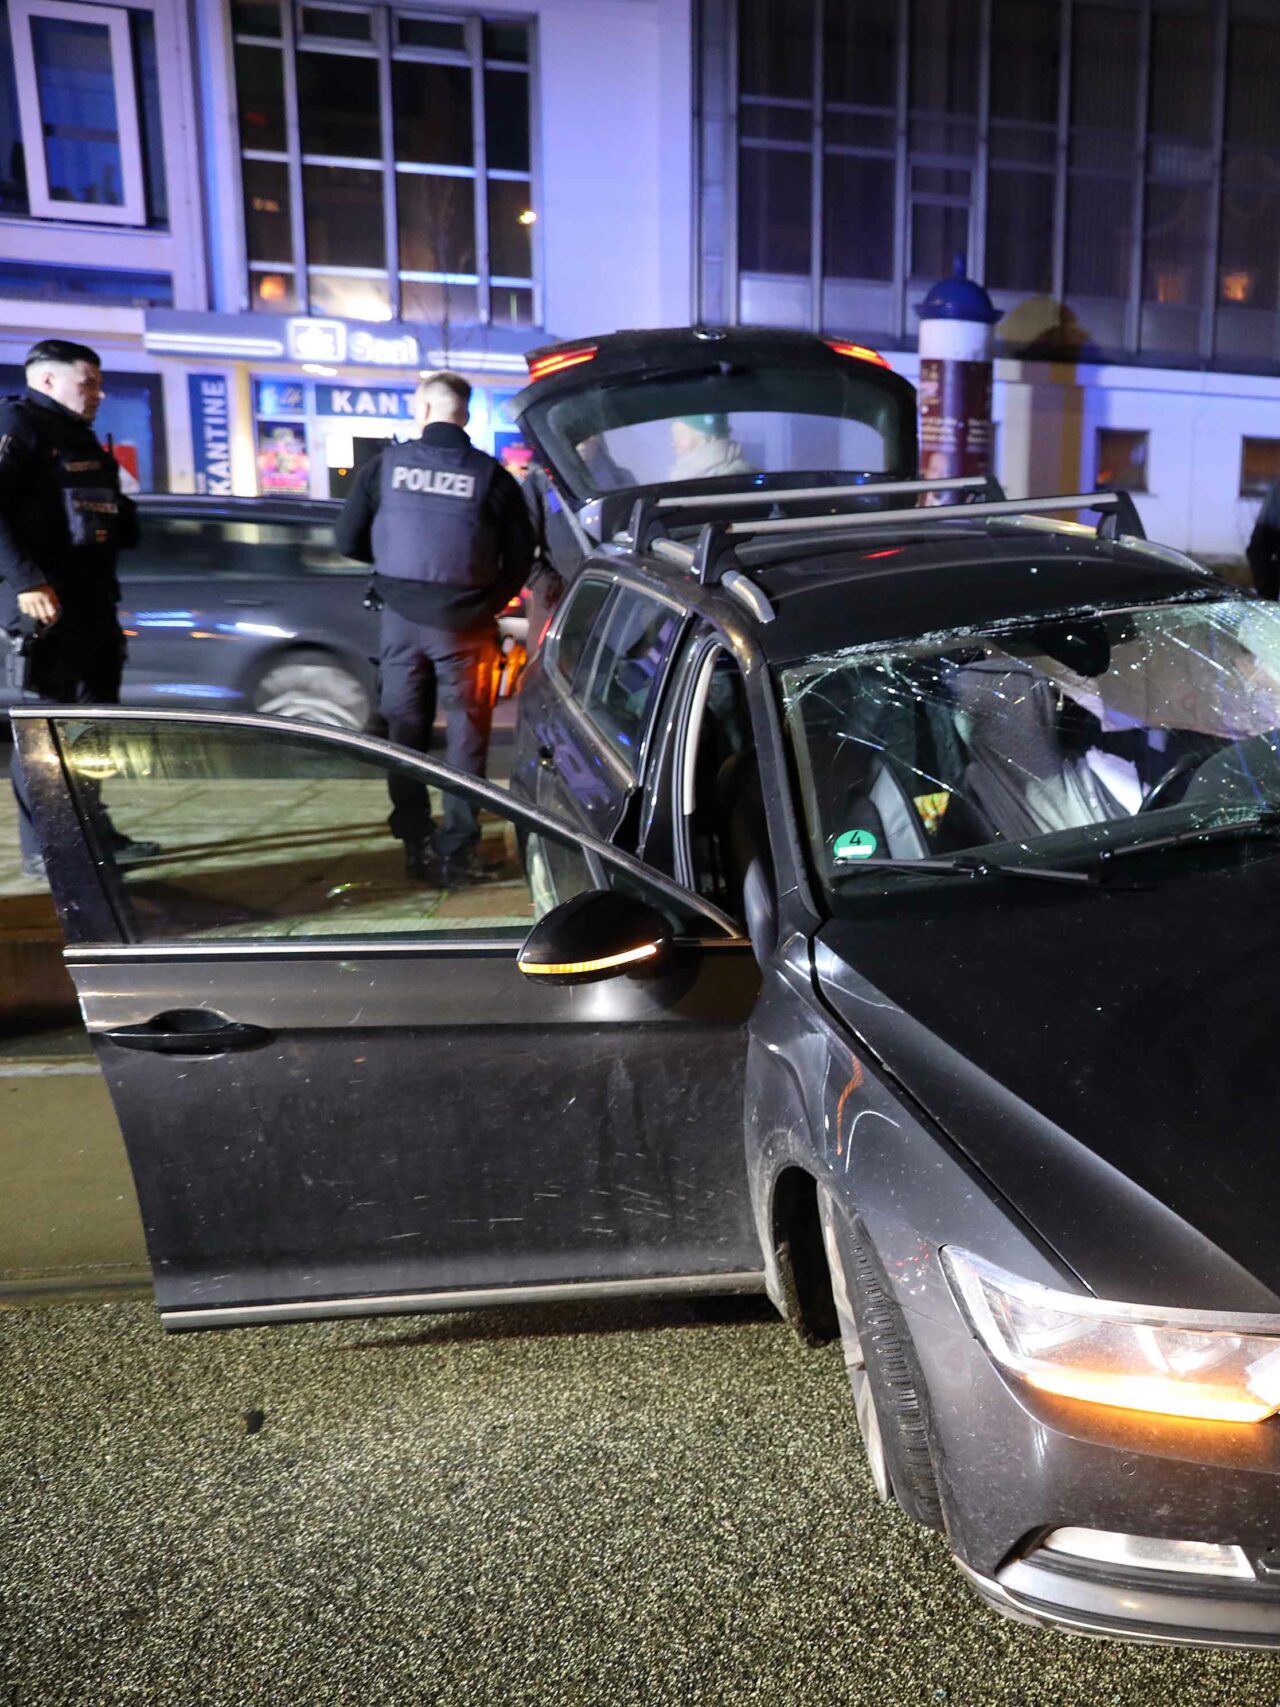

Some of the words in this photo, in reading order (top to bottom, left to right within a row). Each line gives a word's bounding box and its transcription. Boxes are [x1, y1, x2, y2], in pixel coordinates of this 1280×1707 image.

[201, 380, 232, 496] KANTINE
[392, 466, 475, 498] POLIZEI
[849, 831, 862, 846] 4
